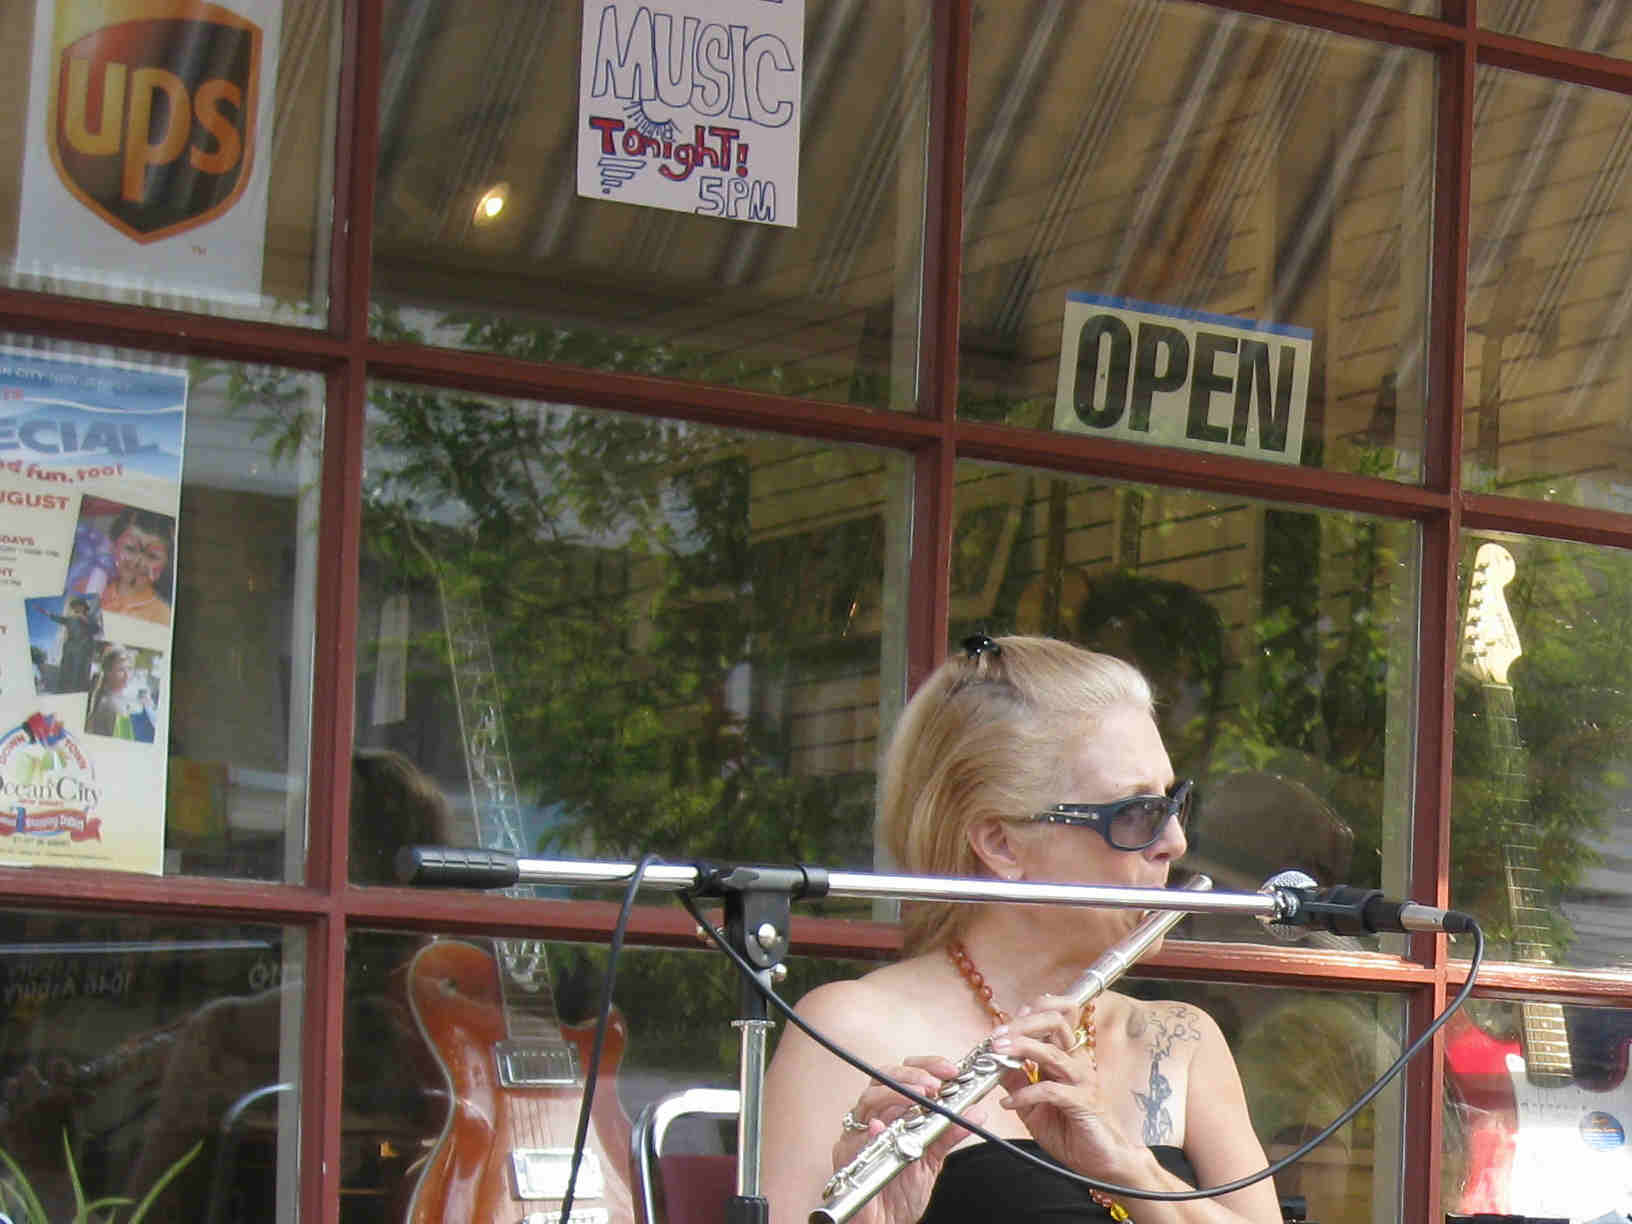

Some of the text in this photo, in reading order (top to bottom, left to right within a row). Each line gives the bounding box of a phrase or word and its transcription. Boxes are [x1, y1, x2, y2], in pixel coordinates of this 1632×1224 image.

[65, 57, 242, 204] ups
[592, 5, 794, 128] MUSIC
[1072, 313, 1297, 453] OPEN
